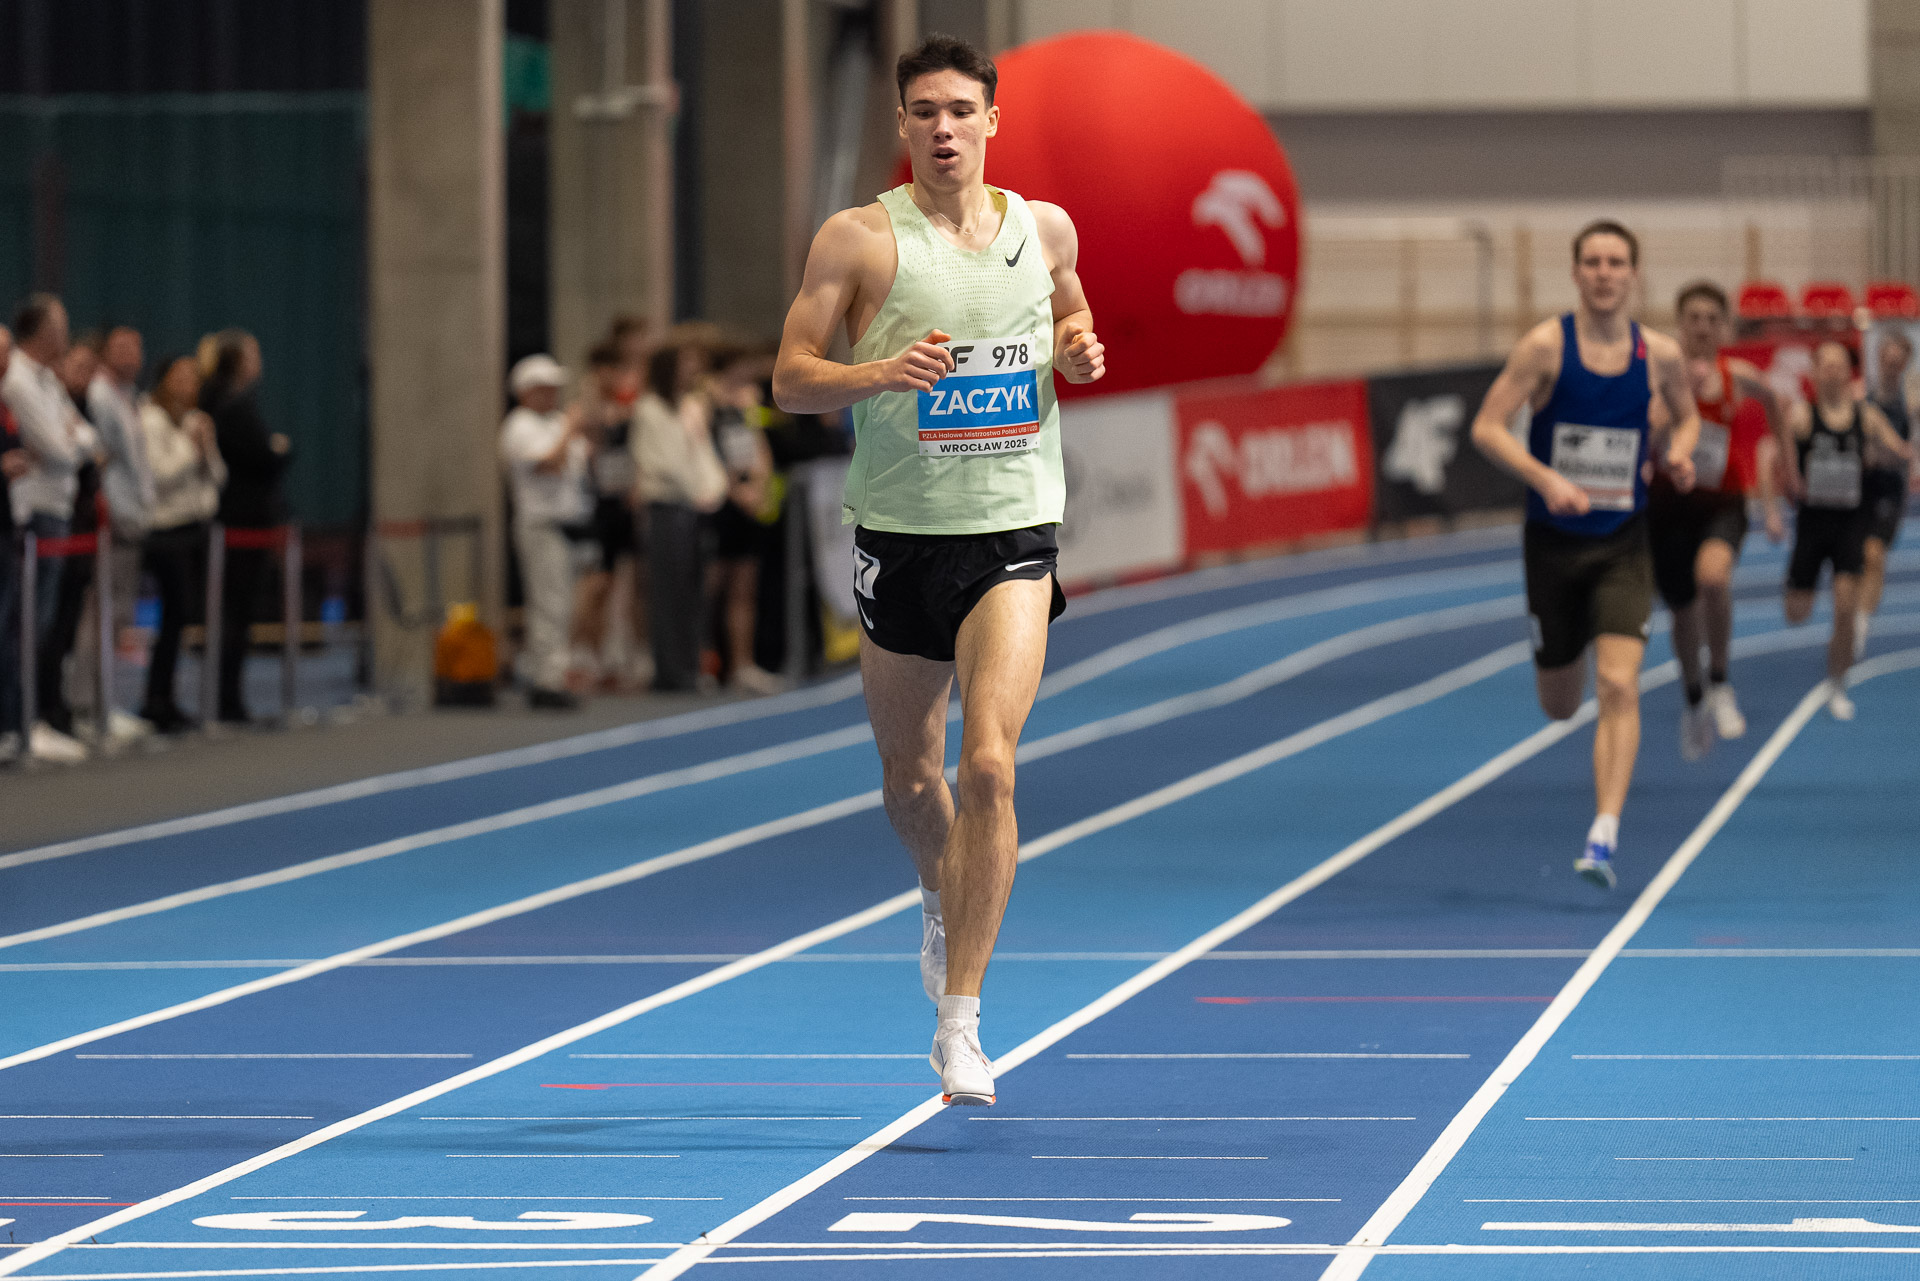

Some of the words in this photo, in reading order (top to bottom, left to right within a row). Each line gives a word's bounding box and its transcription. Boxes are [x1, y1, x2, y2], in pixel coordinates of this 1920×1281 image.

[992, 343, 1029, 368] 978
[929, 383, 1032, 416] ZACZYK
[938, 431, 963, 439] Halowe
[964, 430, 1001, 438] Mistrzostwa
[1001, 427, 1018, 435] Polski
[939, 441, 1003, 453] WROCŁAW
[1004, 438, 1028, 449] 2025
[191, 1211, 654, 1230] 3
[827, 1212, 1292, 1232] 2
